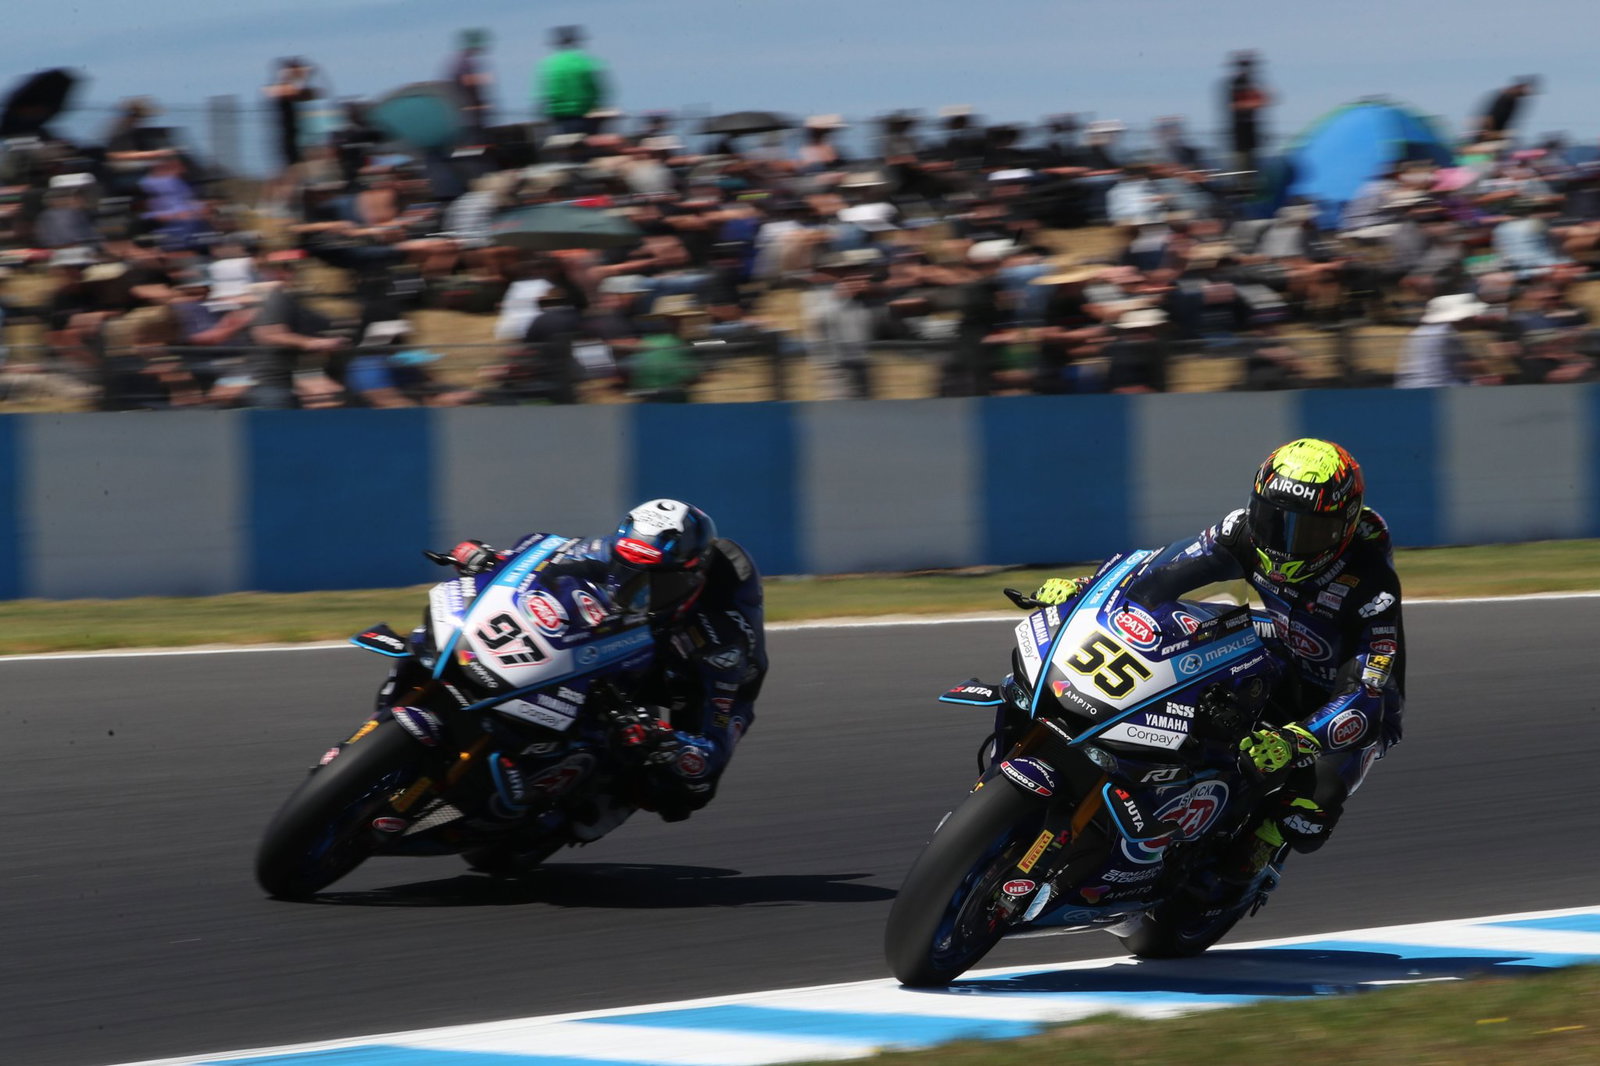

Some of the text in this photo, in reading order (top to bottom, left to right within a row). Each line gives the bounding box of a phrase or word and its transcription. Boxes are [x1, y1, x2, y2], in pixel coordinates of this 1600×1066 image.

[1268, 478, 1316, 501] AIROH
[1031, 612, 1050, 646] YAMAHA
[1120, 615, 1150, 641] PATA
[1134, 610, 1155, 627] SNACK
[476, 612, 547, 666] 97
[1161, 640, 1190, 656] GYTR
[1205, 634, 1256, 662] MAXUS
[1066, 631, 1153, 699] 55
[961, 686, 993, 698] JUTA
[1065, 690, 1098, 715] AMPITO
[1145, 713, 1188, 732] YAMAHA
[1337, 720, 1360, 741] PATA
[1006, 766, 1035, 788] FERODO
[1028, 760, 1055, 787] WORLD
[1123, 800, 1145, 832] JUTA
[1020, 832, 1051, 870] PIRELLI
[1009, 885, 1031, 894] HEL
